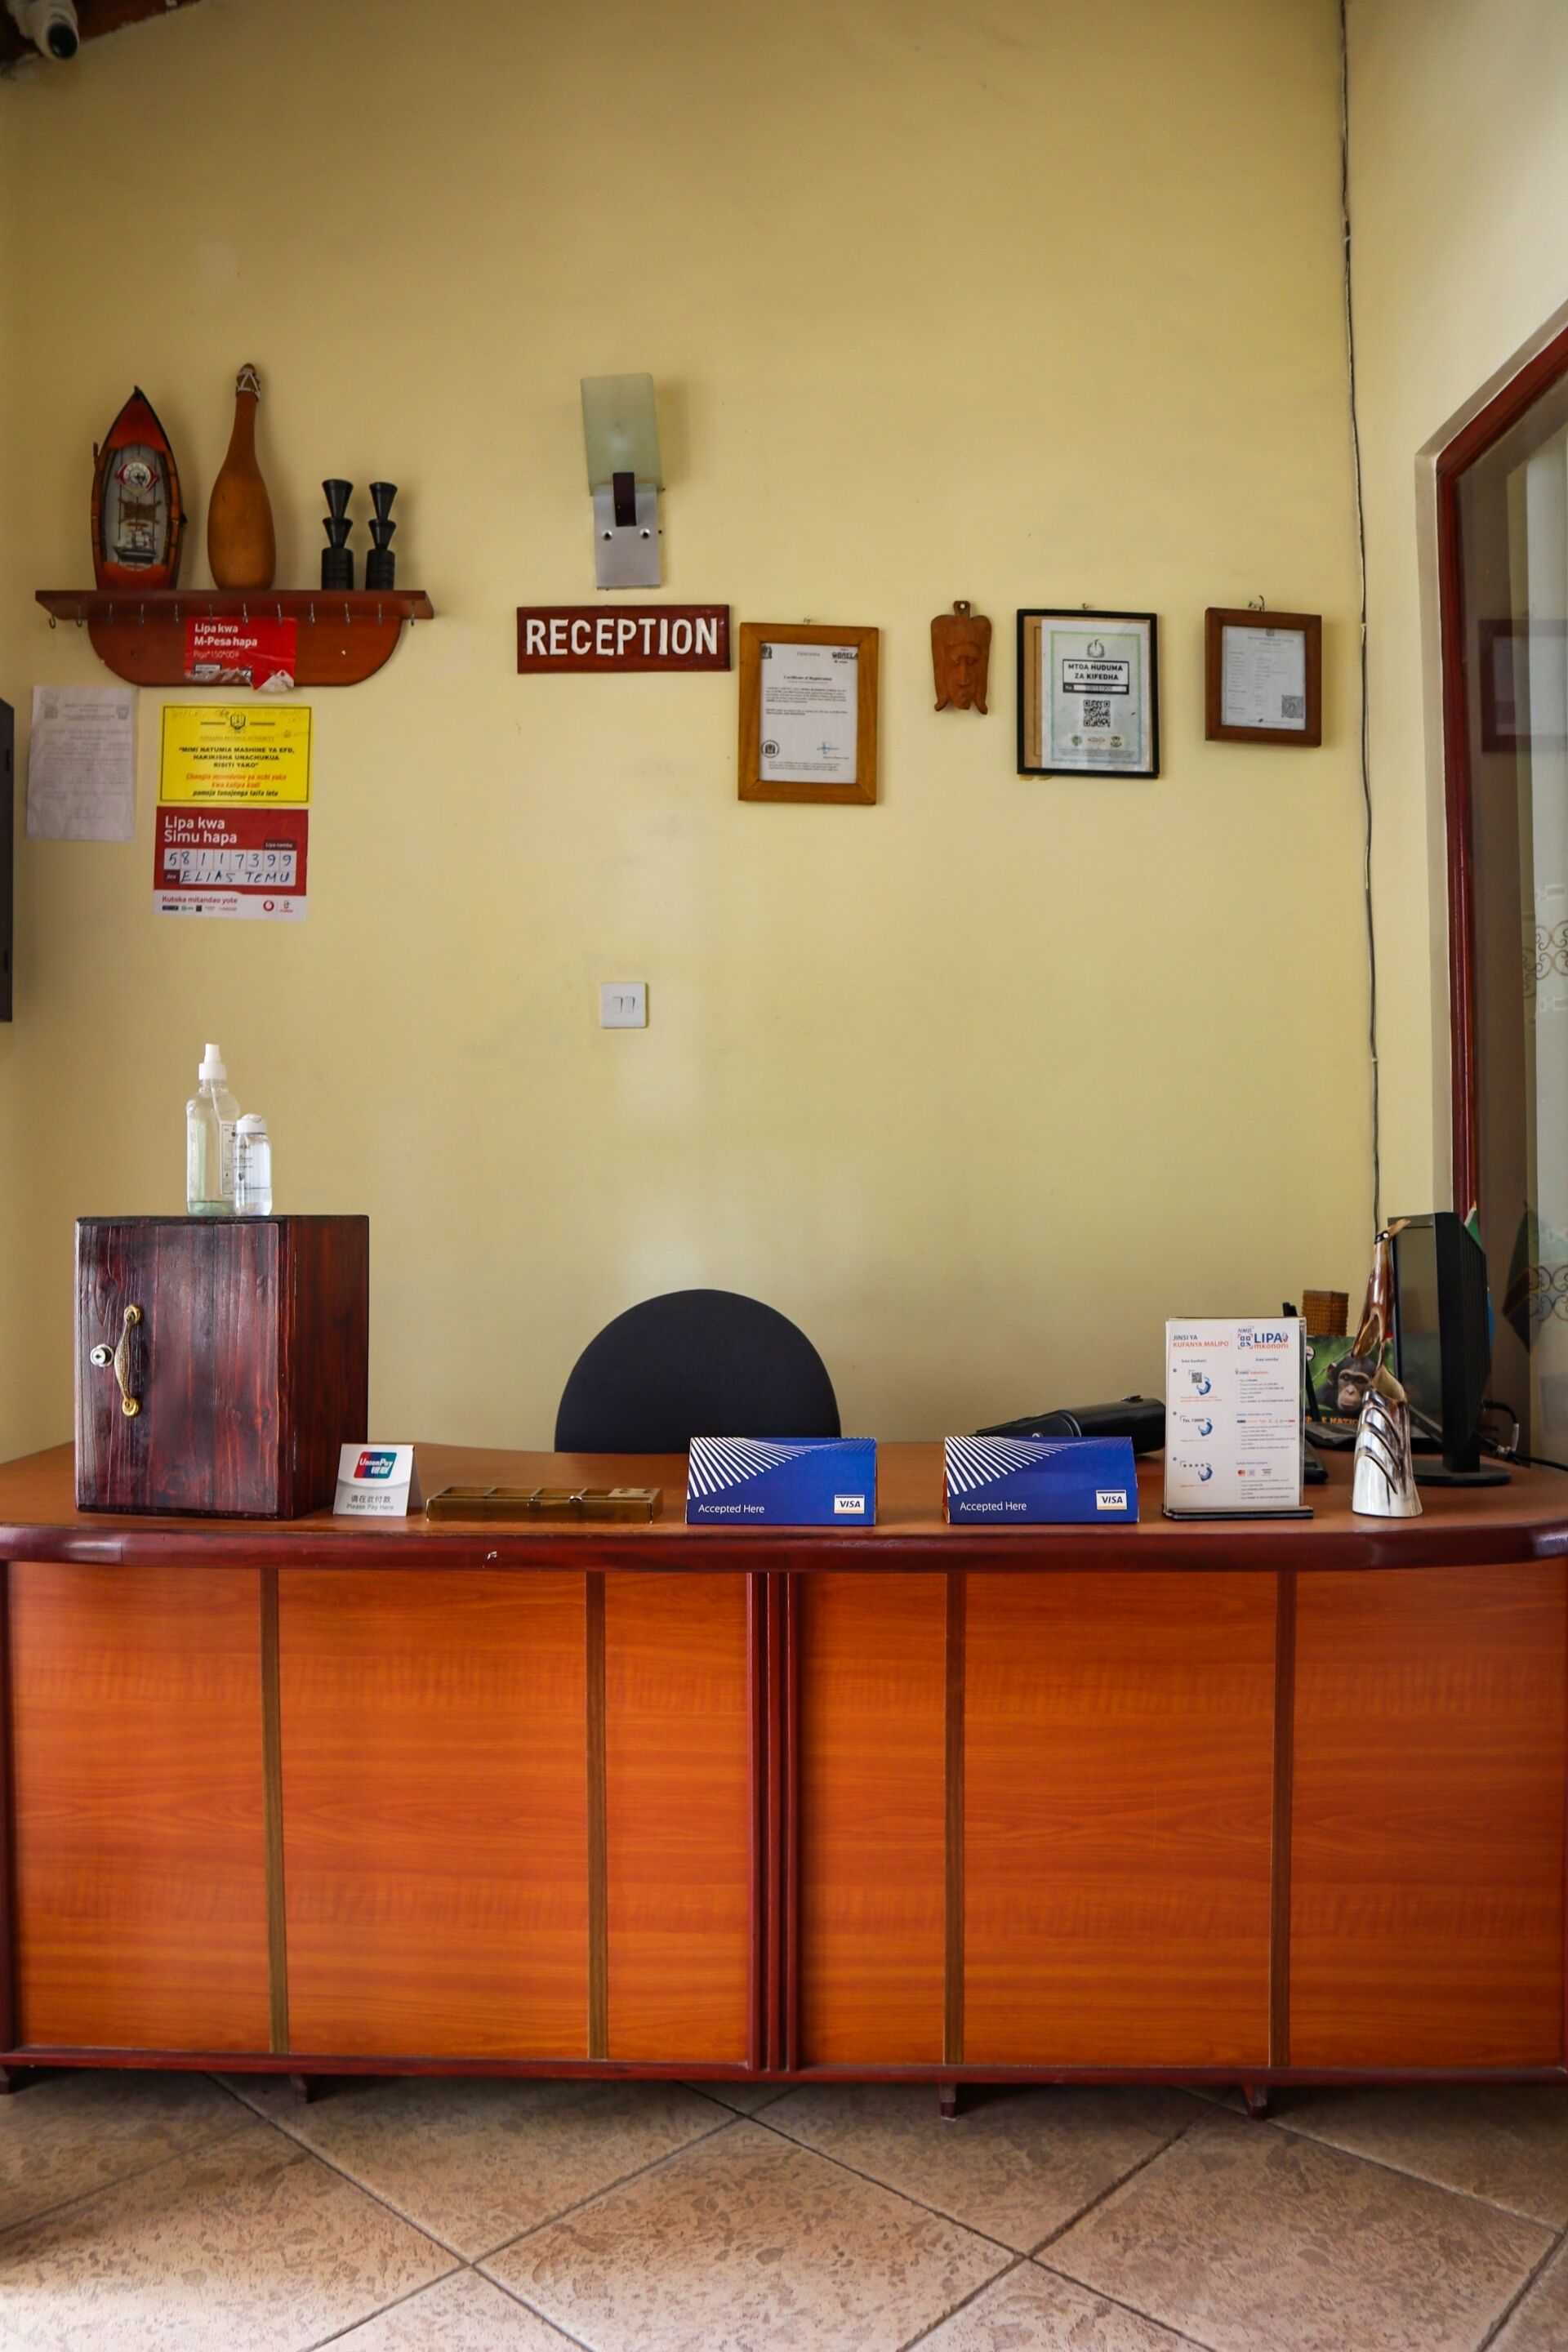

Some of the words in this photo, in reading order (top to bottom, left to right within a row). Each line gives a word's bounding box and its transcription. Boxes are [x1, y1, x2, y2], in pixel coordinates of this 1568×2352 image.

[194, 623, 216, 635] Lipa
[218, 623, 238, 634] kwa
[194, 635, 232, 646] M-Pesa
[233, 637, 258, 648] hapa
[526, 617, 718, 657] RECEPTION
[165, 816, 194, 831] Lipa
[198, 817, 225, 830] kwa
[164, 830, 199, 843] Simu
[203, 831, 237, 846] hapa
[181, 870, 235, 883] ELIAS
[1254, 1333, 1282, 1343] LIPA
[359, 1458, 393, 1469] UnionPay
[839, 1500, 861, 1508] VISA
[1101, 1496, 1123, 1504] VISA
[698, 1503, 742, 1515] Accepted
[743, 1503, 764, 1514] Here
[960, 1501, 1004, 1512] Accepted
[1005, 1501, 1027, 1511] Here
